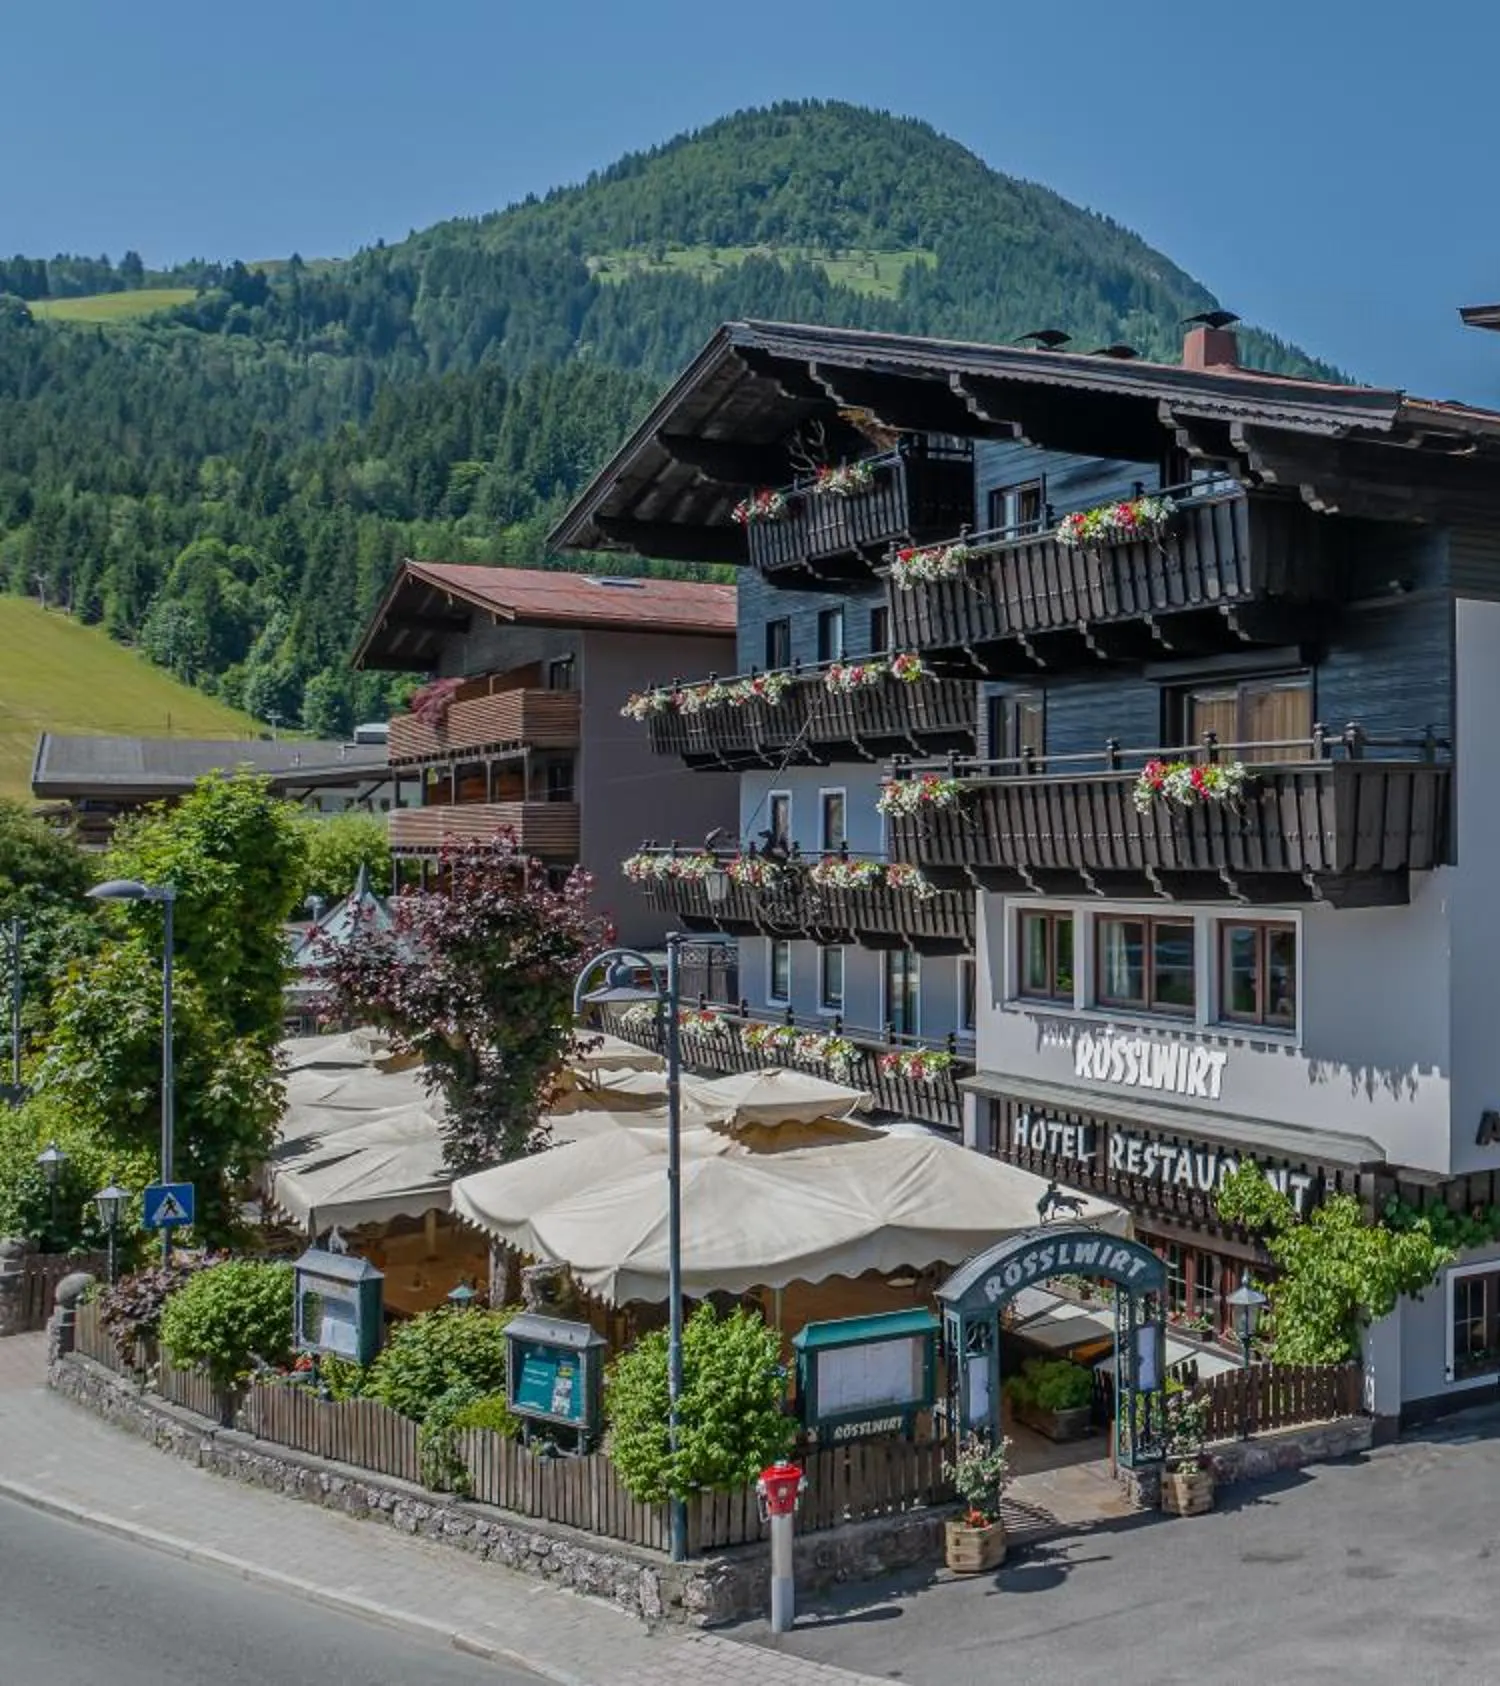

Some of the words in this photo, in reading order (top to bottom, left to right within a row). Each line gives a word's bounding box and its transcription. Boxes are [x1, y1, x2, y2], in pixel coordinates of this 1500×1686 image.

[1075, 1024, 1227, 1099] RÖSSLWIRT
[1013, 1112, 1096, 1162] HOTEL
[1109, 1131, 1312, 1214] RESTAURNT
[984, 1241, 1147, 1302] RÖSSLWIRT
[834, 1416, 905, 1440] RÖSSLWIRT
